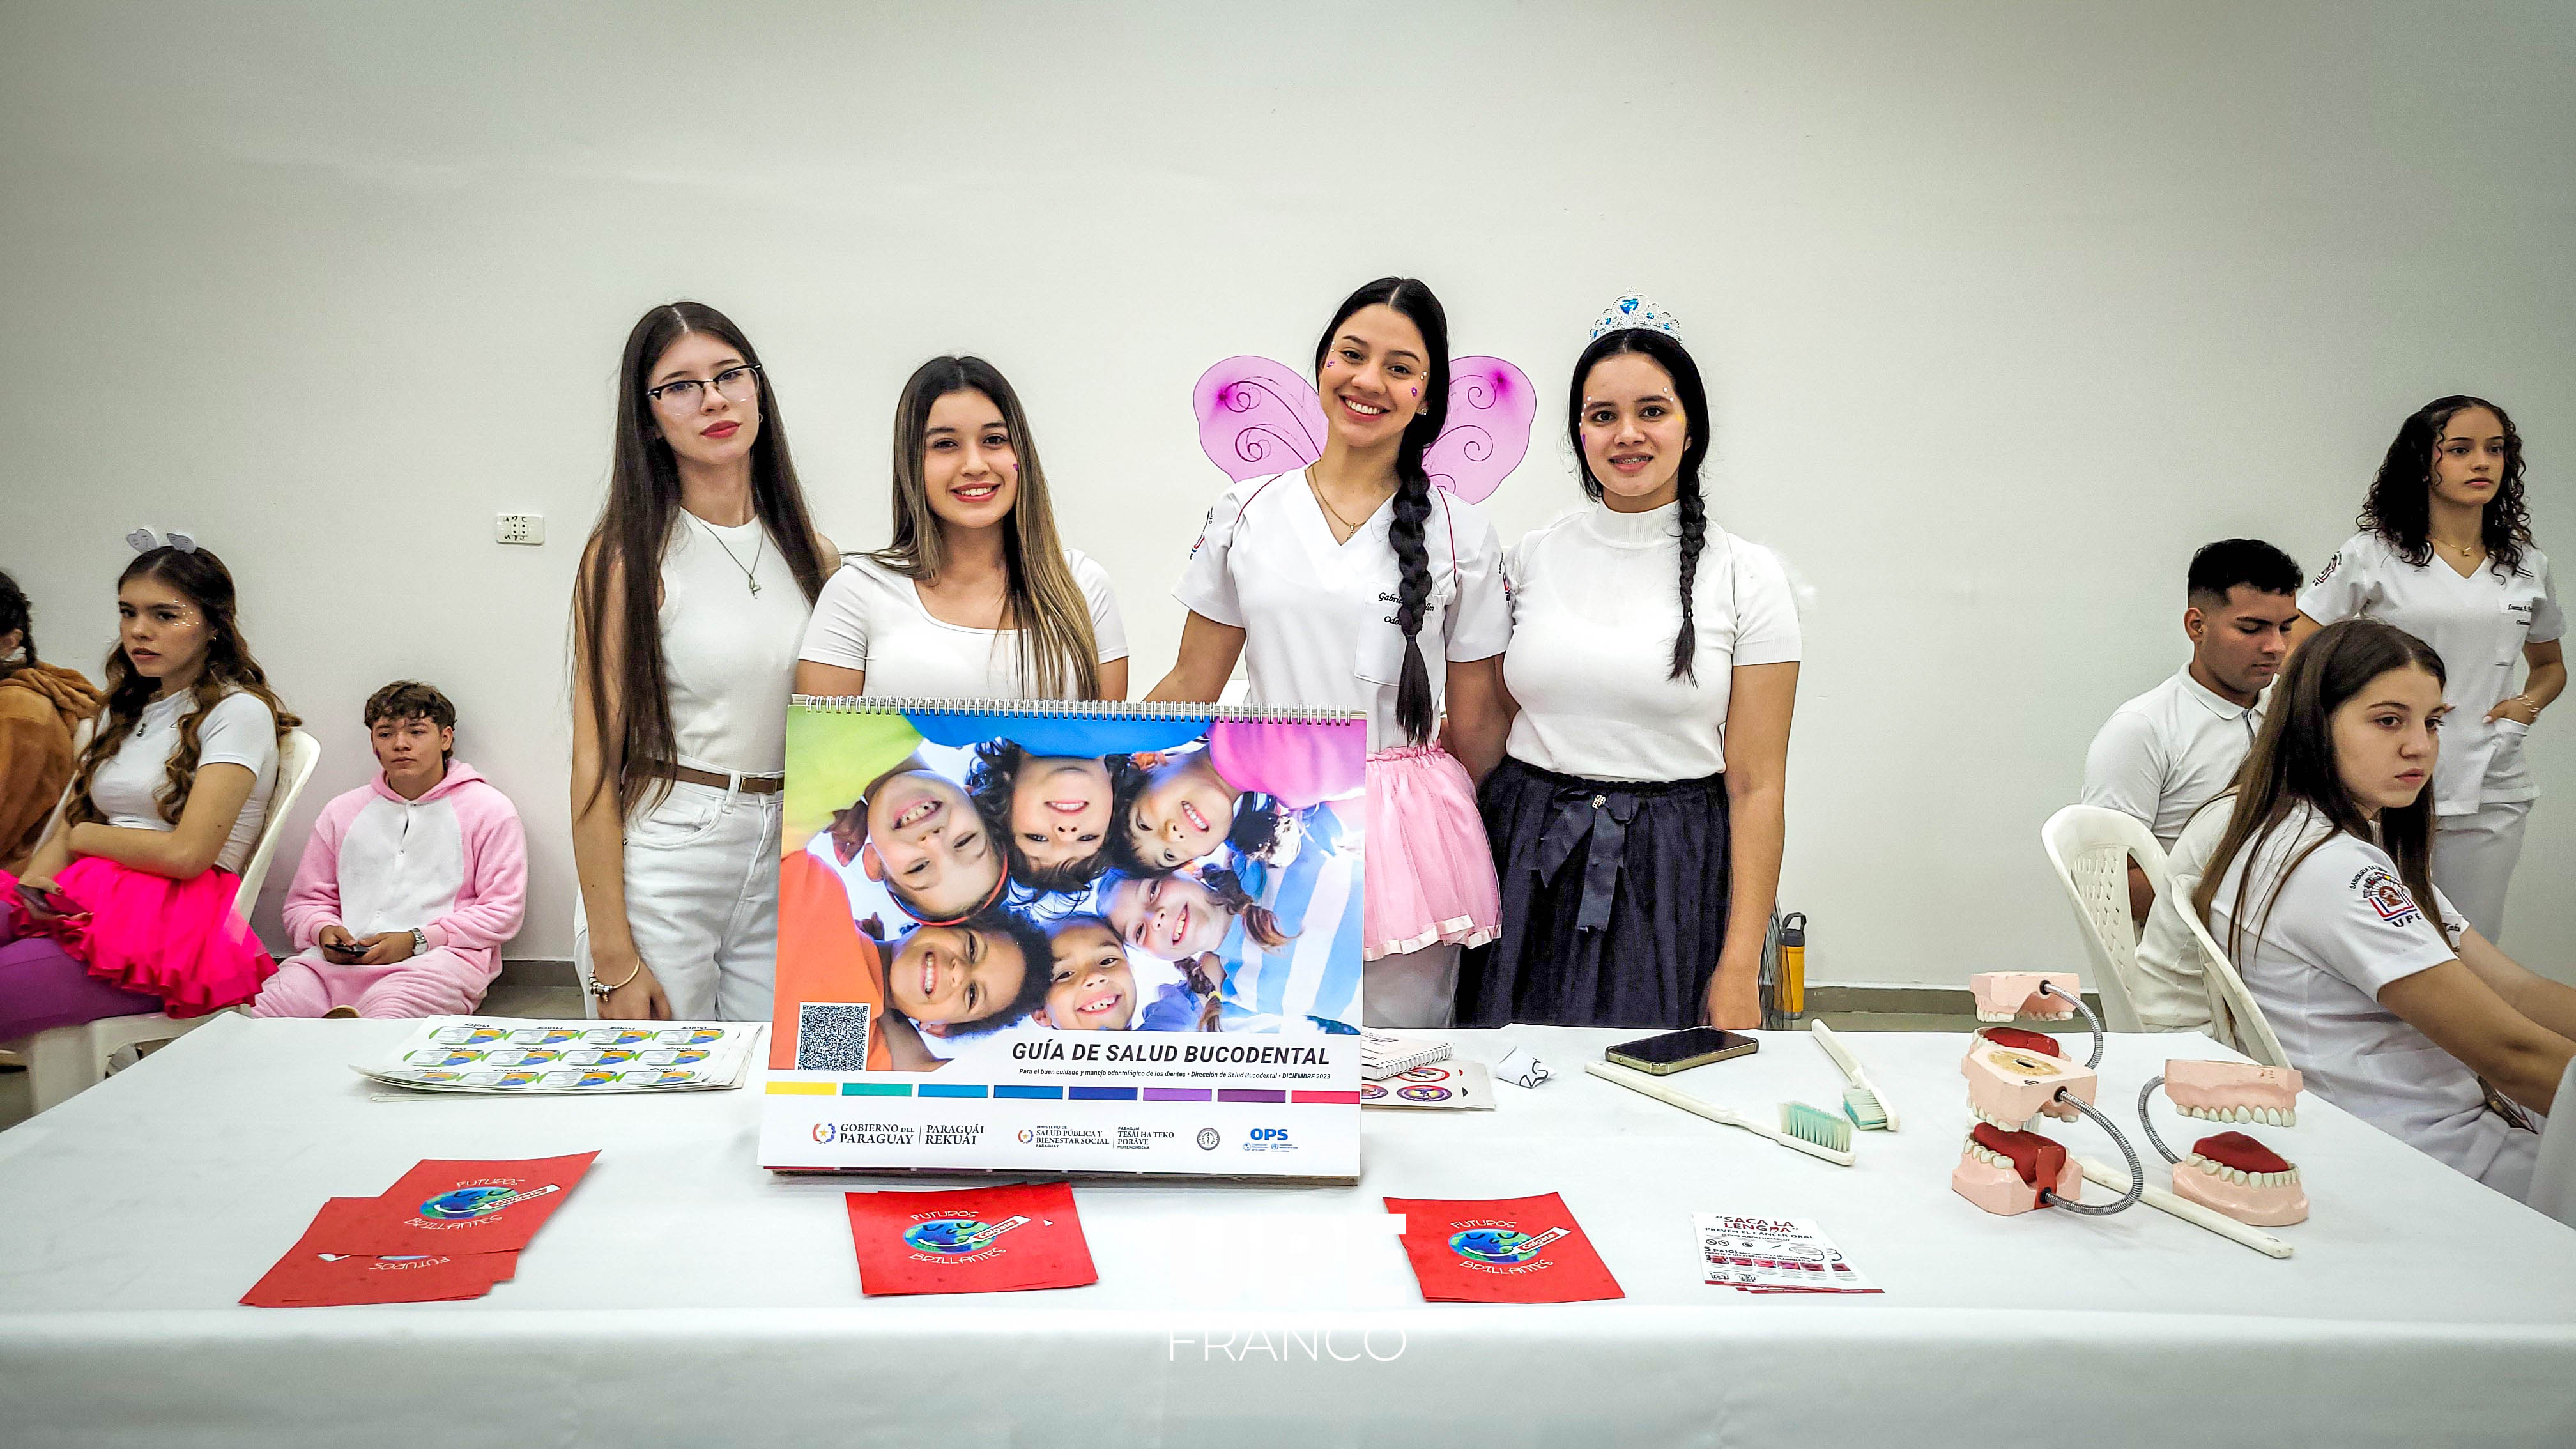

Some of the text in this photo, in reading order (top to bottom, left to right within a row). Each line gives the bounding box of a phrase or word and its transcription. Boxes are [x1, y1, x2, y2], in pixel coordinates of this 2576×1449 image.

[2391, 913, 2422, 928] UPE
[1012, 1038, 1330, 1065] GUÍA DE SALUD BUCODENTAL
[840, 1123, 899, 1132] GOBIERNO
[1063, 1128, 1096, 1137] PÚBLICA
[1250, 1128, 1289, 1140] OPS
[839, 1133, 914, 1144] PARAGUAY
[925, 1133, 977, 1145] REKUÁI
[909, 1210, 979, 1221] FUTUROS
[404, 1215, 503, 1230] BRILLANTES
[1450, 1220, 1517, 1229] FUTUROS
[979, 1221, 1015, 1239] Colgate
[1522, 1233, 1556, 1250] Colgate
[908, 1247, 1007, 1264] BRILLANTES
[1459, 1259, 1554, 1275] BRILLANTES
